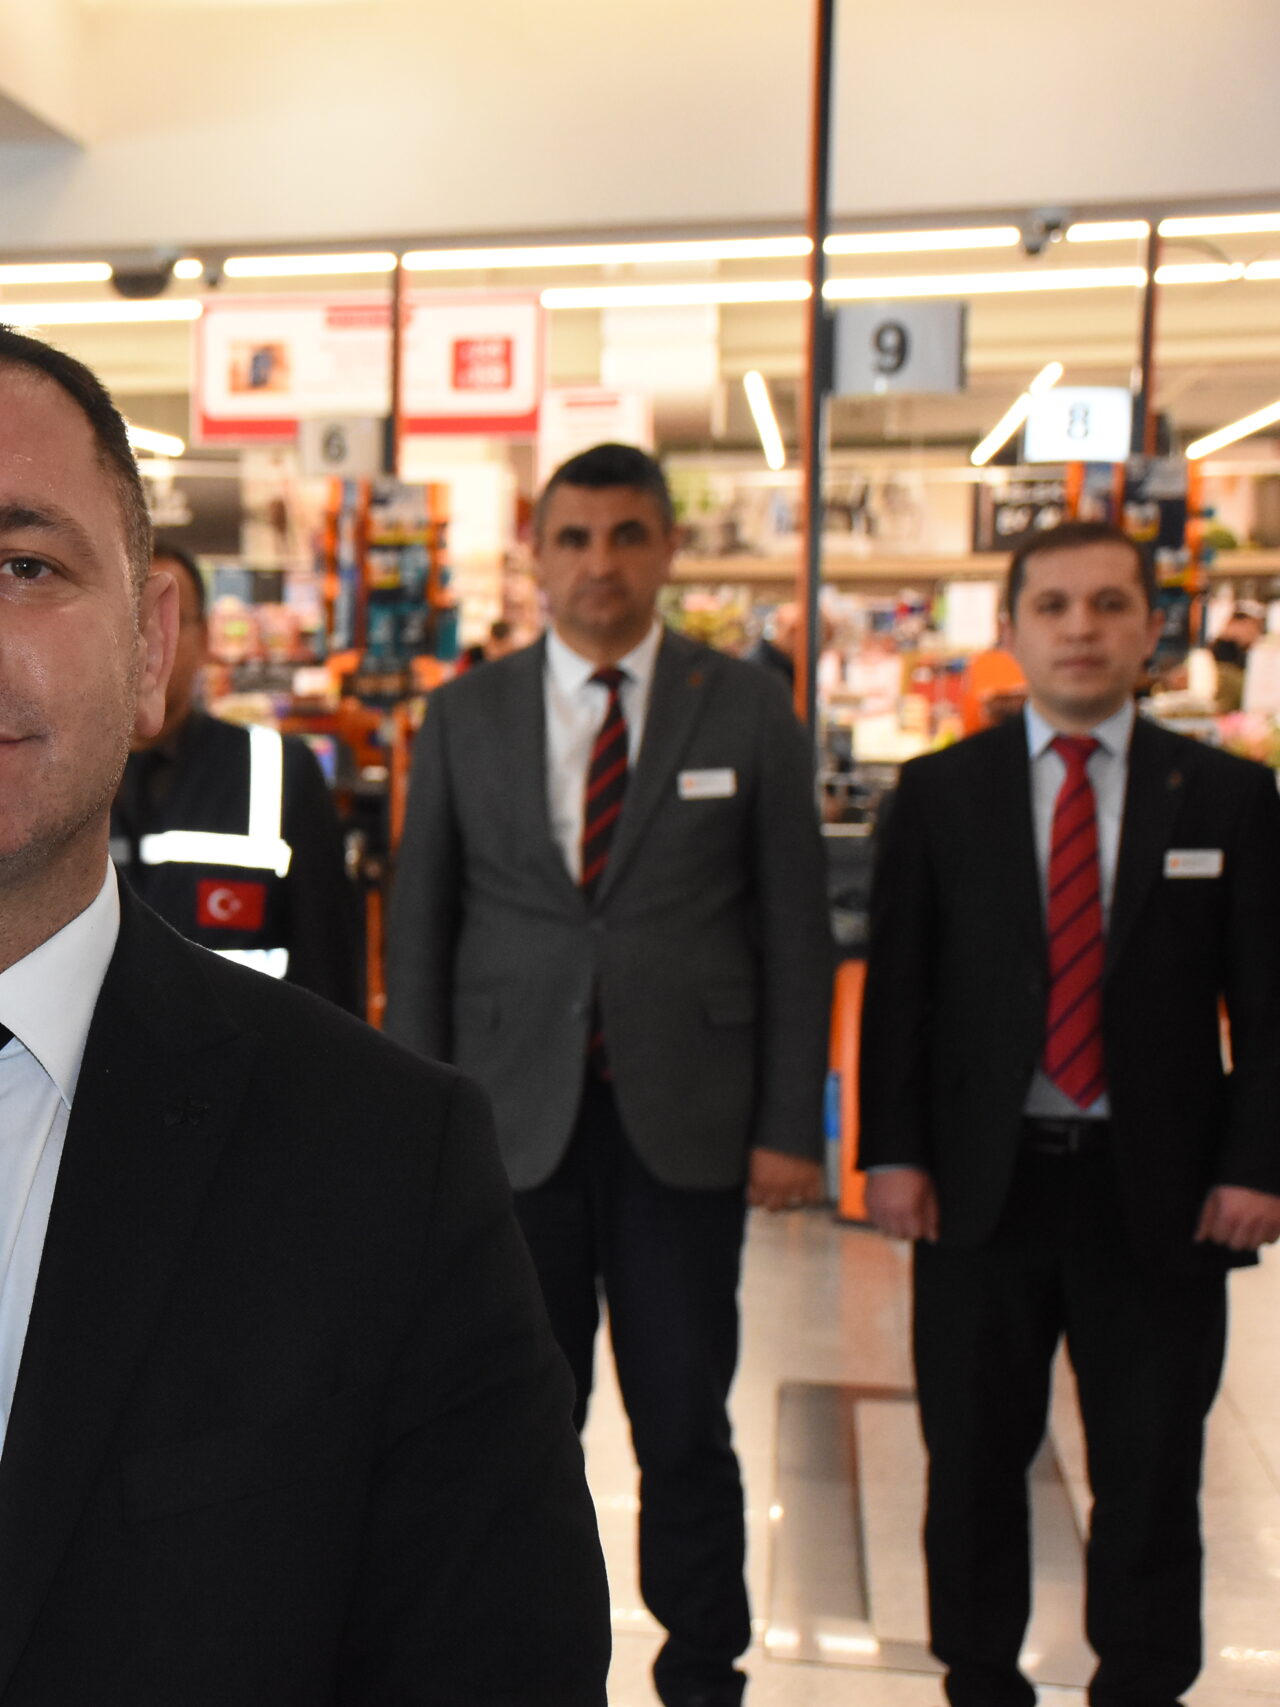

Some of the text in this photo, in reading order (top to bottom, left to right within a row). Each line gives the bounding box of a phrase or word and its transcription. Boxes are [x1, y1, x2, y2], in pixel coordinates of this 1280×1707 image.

[872, 320, 909, 376] 9
[1066, 401, 1090, 439] 8
[321, 424, 348, 463] 6
